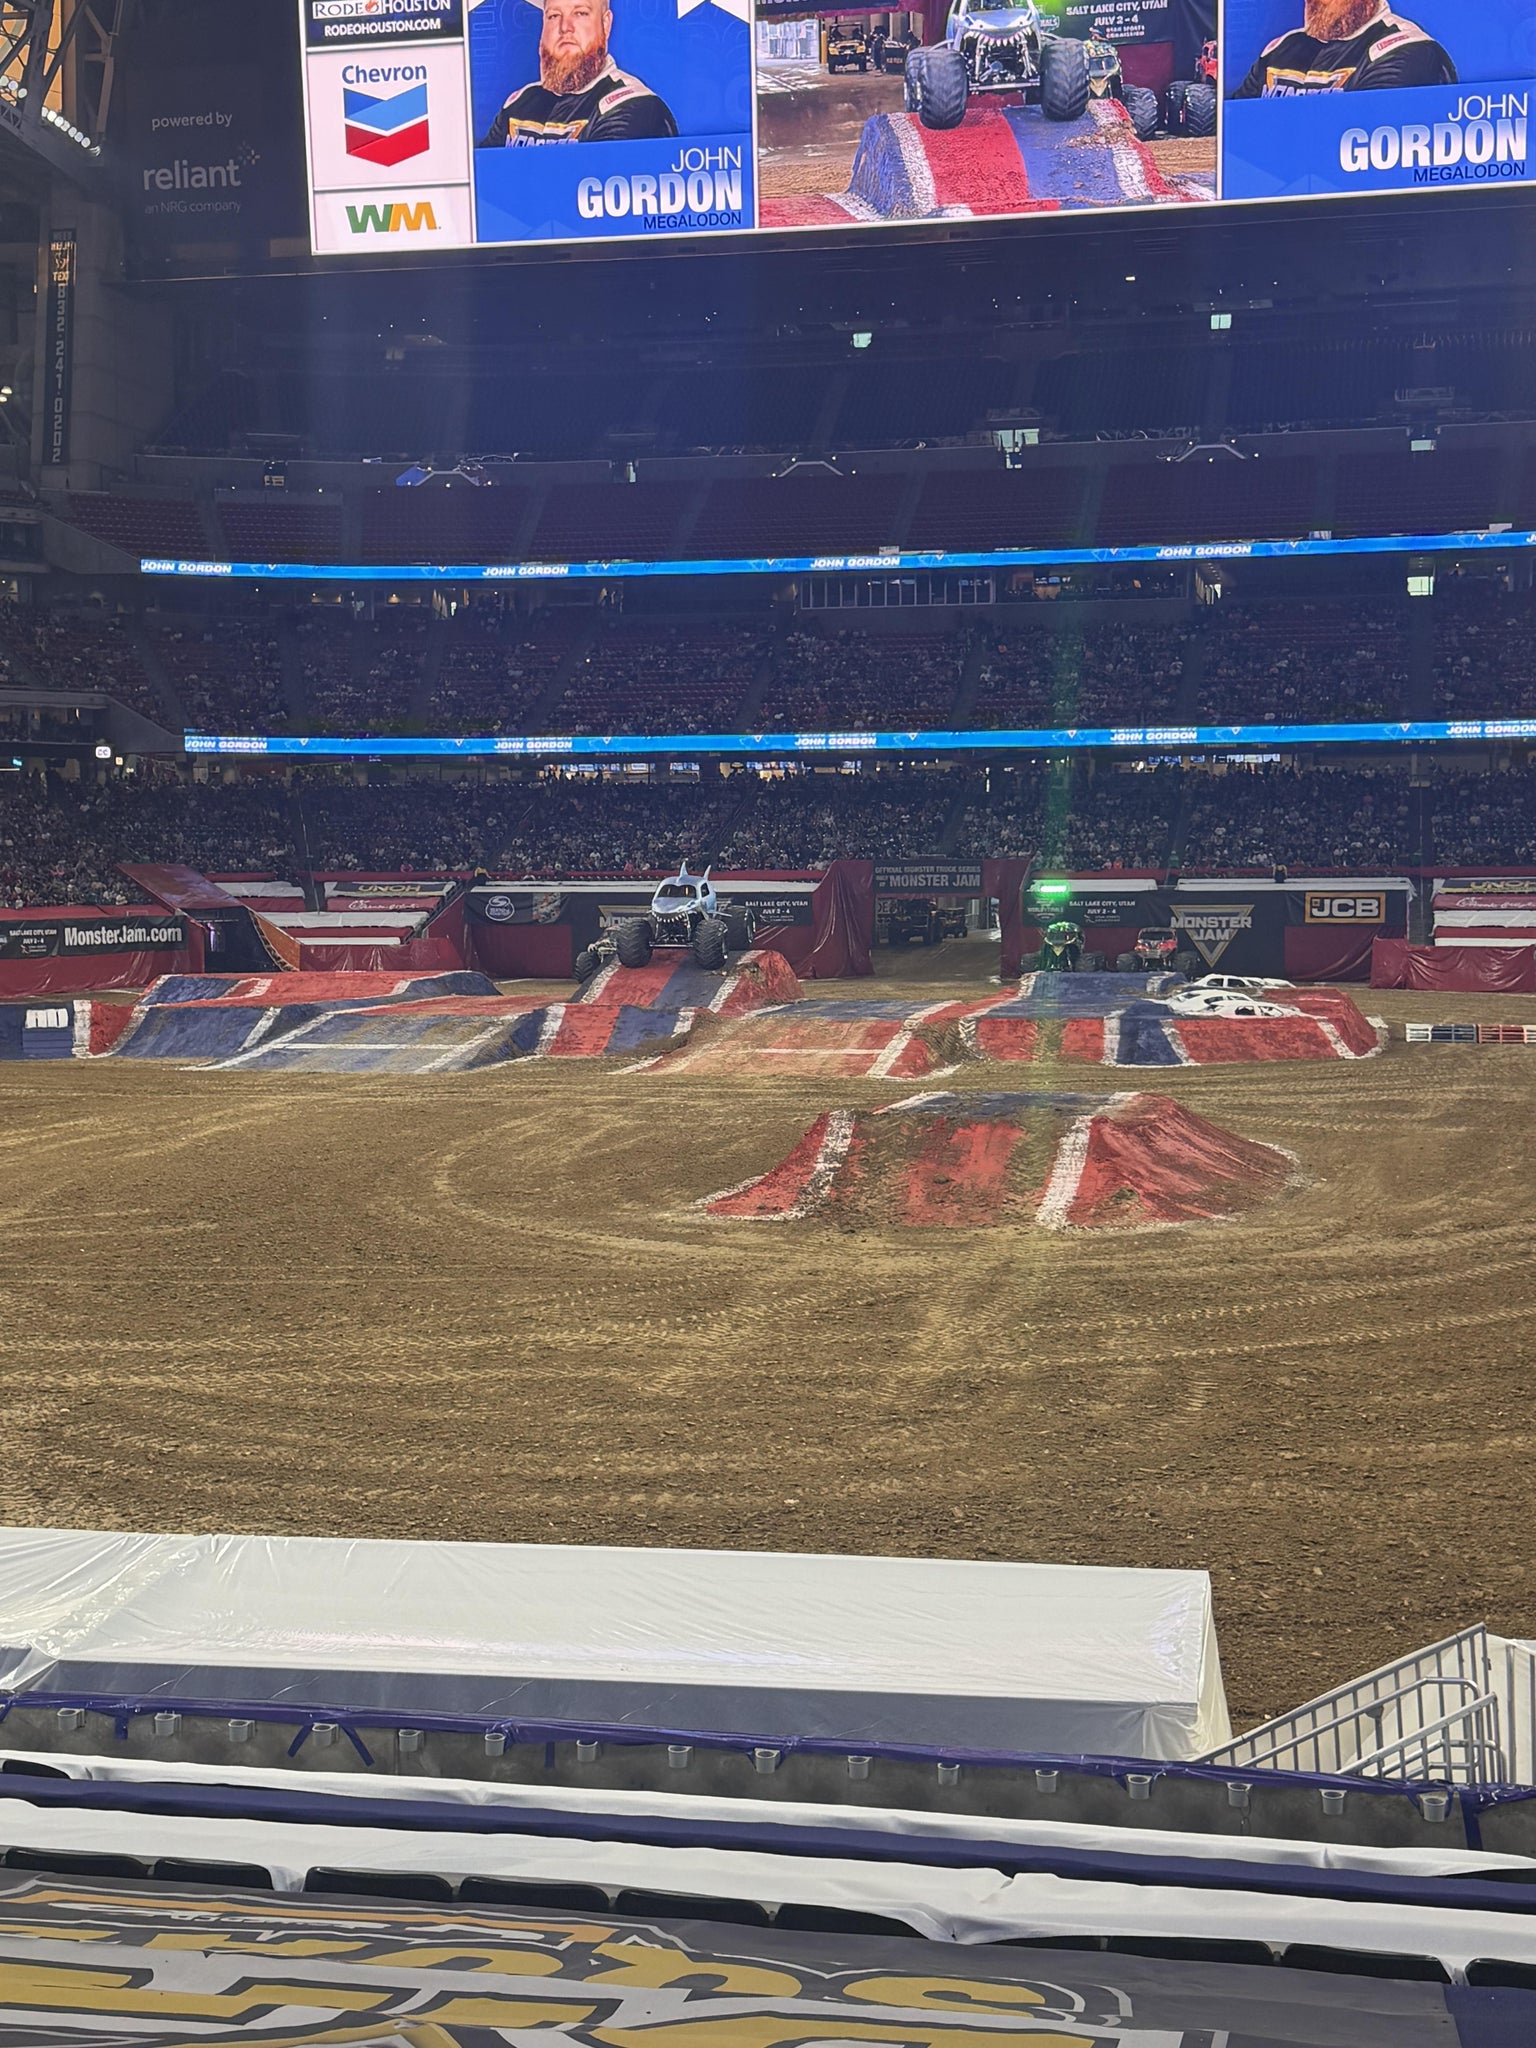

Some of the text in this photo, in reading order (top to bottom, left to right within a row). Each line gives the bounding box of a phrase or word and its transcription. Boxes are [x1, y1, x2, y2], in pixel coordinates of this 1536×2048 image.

[1066, 0, 1168, 16] SALT LAKE CITY, UTAH
[325, 18, 441, 36] RODEOHOUSTON.COM
[1094, 16, 1115, 26] JULY
[1116, 16, 1124, 25] 2
[1131, 14, 1139, 24] 4
[342, 65, 427, 84] Chevron
[1447, 92, 1529, 122] JOHN
[151, 112, 233, 131] powered by
[1339, 117, 1528, 172] GORDON
[671, 145, 742, 173] JOHN
[143, 159, 242, 190] reliant
[1413, 162, 1526, 182] MEGALODON
[577, 169, 743, 219] GORDON
[145, 200, 241, 214] an NRG company
[643, 211, 742, 229] MEGALODON
[1156, 545, 1252, 557] JOHN GORDON
[141, 561, 232, 573] JOHN GORDON
[810, 556, 900, 568] JOHN GORDON
[482, 566, 569, 576] JOHN GORDON
[1110, 731, 1198, 741] JOHN GORDON
[1446, 725, 1481, 735] JOHN
[185, 740, 267, 749] JOHN GORDON
[494, 741, 573, 749] JOHN GORDON
[794, 736, 877, 746] JOHN GORDON
[889, 874, 949, 888] MONSTER
[952, 873, 980, 887] JAM
[358, 885, 421, 893] UNOH
[1311, 898, 1379, 917] JCB
[1170, 915, 1252, 928] MONSTER
[64, 925, 182, 946] MonsterJam.com
[1192, 928, 1231, 941] JAM
